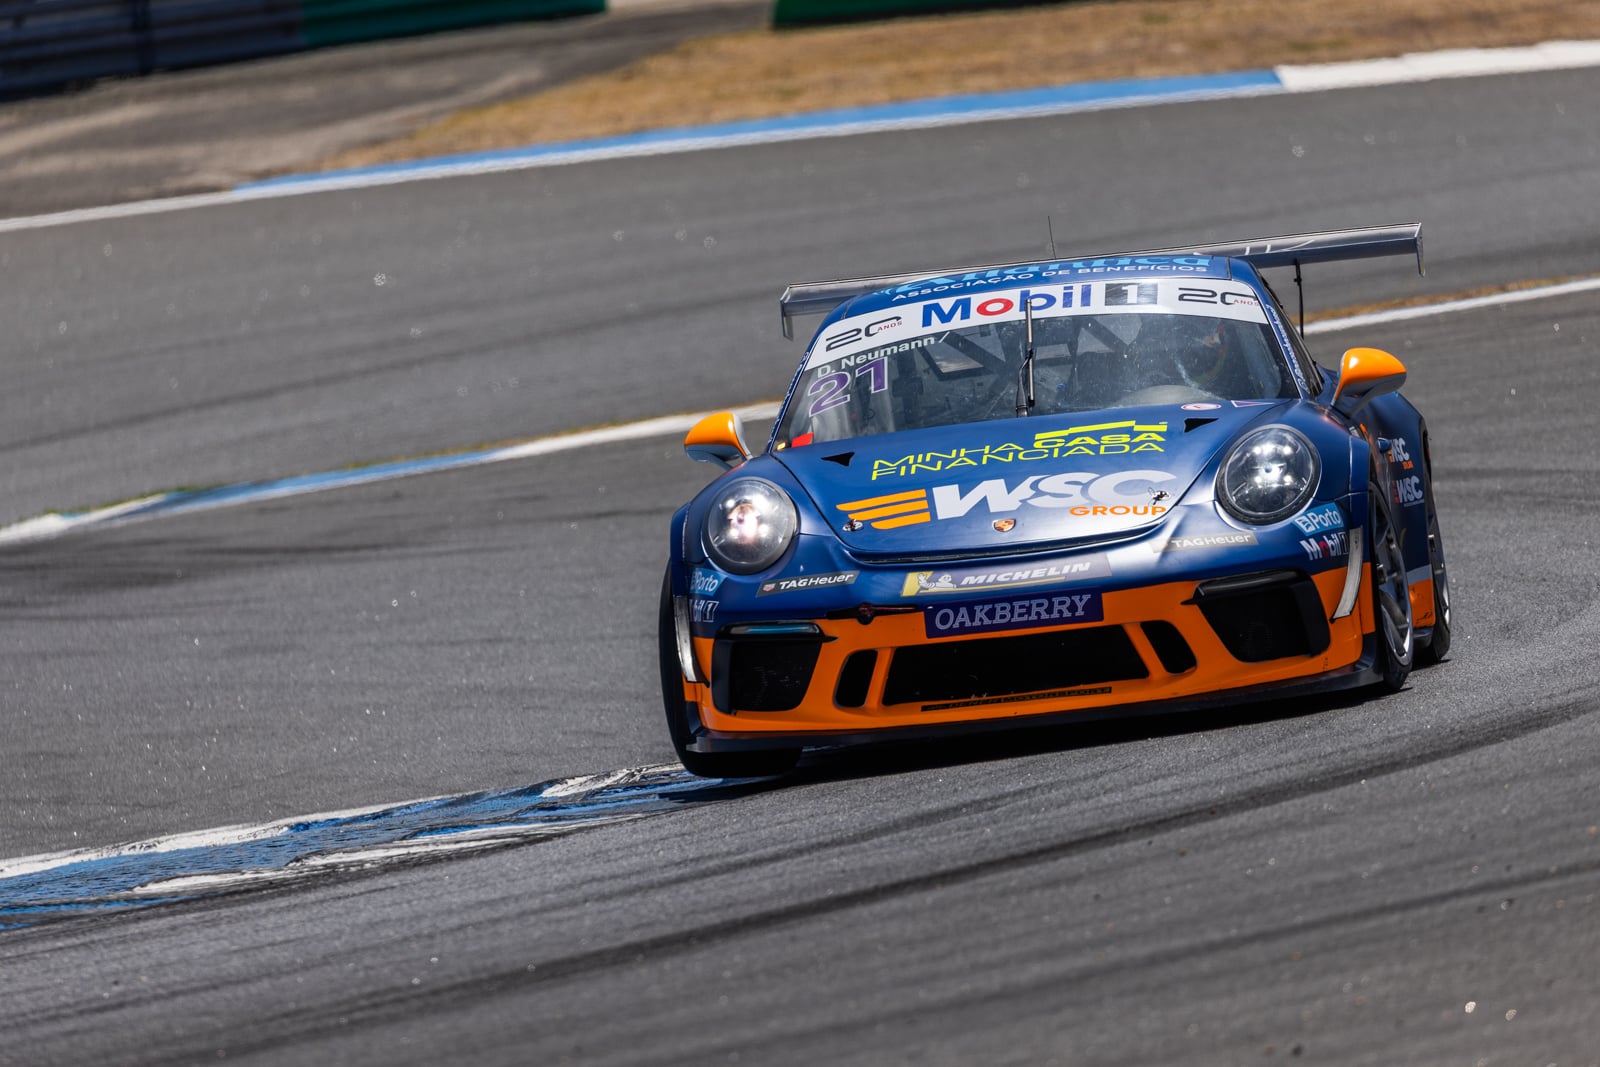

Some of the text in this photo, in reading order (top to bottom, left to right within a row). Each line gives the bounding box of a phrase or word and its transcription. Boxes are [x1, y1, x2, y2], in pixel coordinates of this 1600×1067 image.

[892, 264, 1207, 301] ASSOCIAÇÃO DE BENEFÍCIOS
[921, 284, 1092, 328] Mobil
[1233, 298, 1260, 307] ANOS
[877, 320, 903, 332] ANOS
[817, 364, 836, 379] D.
[841, 335, 935, 369] Neumann
[808, 356, 888, 417] 21
[872, 442, 1166, 481] FINANCIADA
[873, 431, 1168, 470] MINHA CASA
[932, 470, 1178, 520] WSC
[1069, 505, 1168, 517] GROUP
[1307, 508, 1342, 530] Porto
[1299, 533, 1341, 561] Mobil
[961, 561, 1091, 586] MICHELIN
[935, 594, 1093, 631] OAKBERRY
